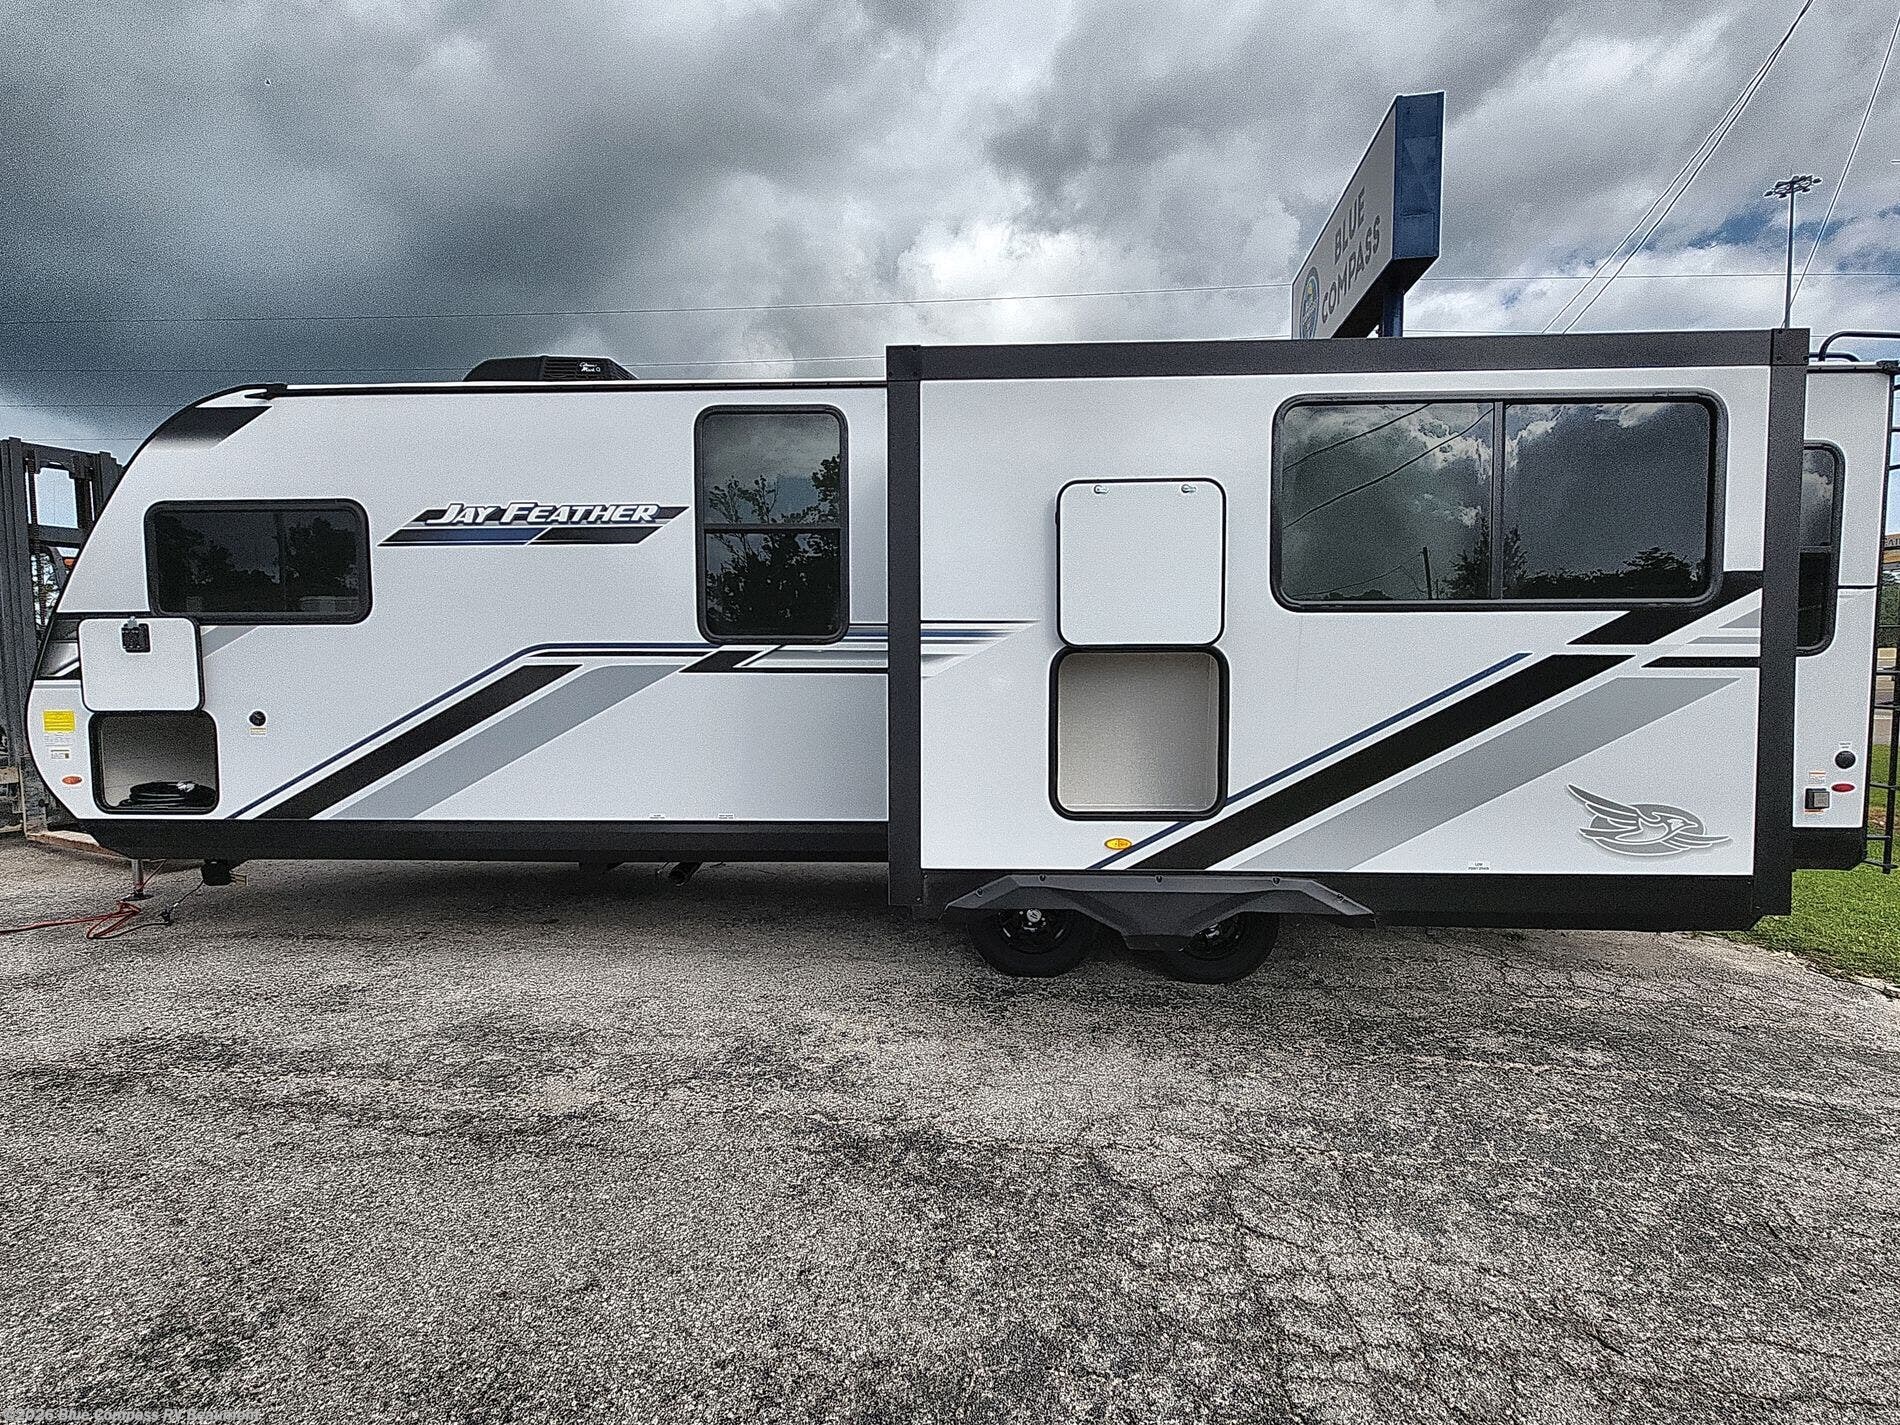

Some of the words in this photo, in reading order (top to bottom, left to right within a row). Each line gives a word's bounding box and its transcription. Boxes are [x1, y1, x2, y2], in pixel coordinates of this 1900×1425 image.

[1334, 186, 1365, 265] BLUE
[1321, 214, 1381, 324] COMPASS
[425, 502, 499, 526] JAY
[500, 501, 660, 525] FEATHER
